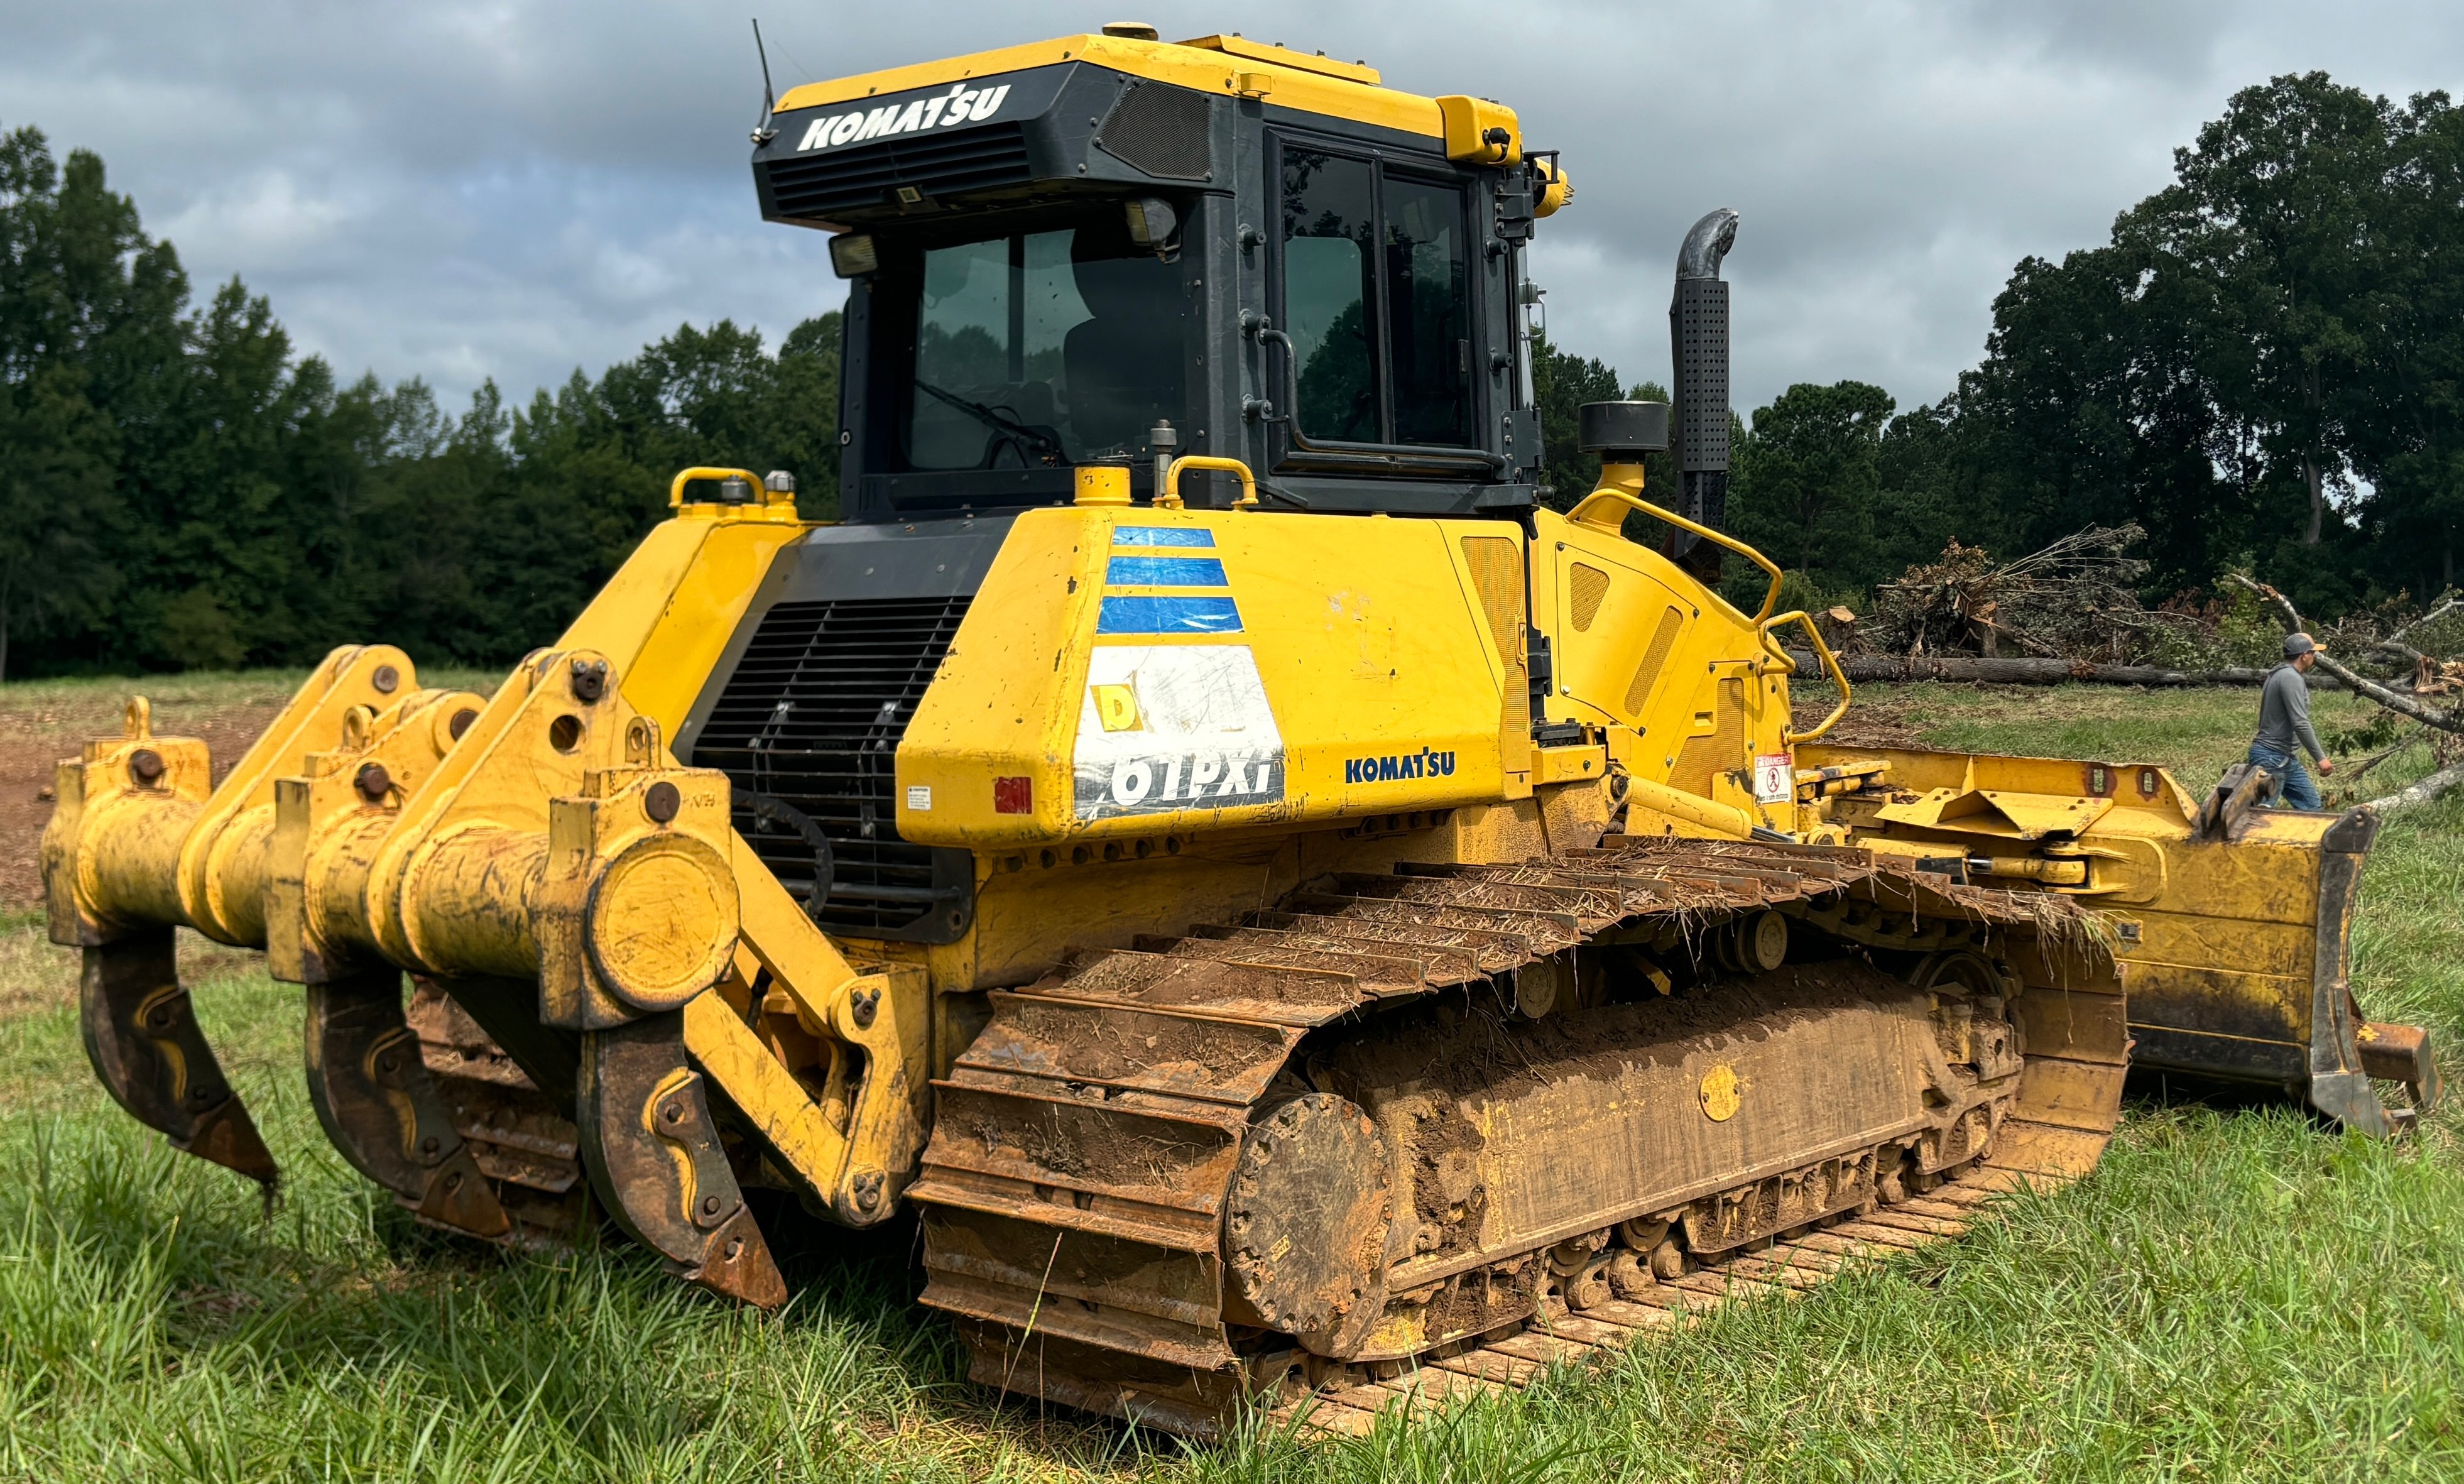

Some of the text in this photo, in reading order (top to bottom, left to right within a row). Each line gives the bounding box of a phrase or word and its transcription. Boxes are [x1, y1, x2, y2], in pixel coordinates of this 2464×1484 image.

[796, 83, 1012, 151] KOMATSU
[1098, 684, 1137, 731] D
[1345, 746, 1455, 784] KOMATSU
